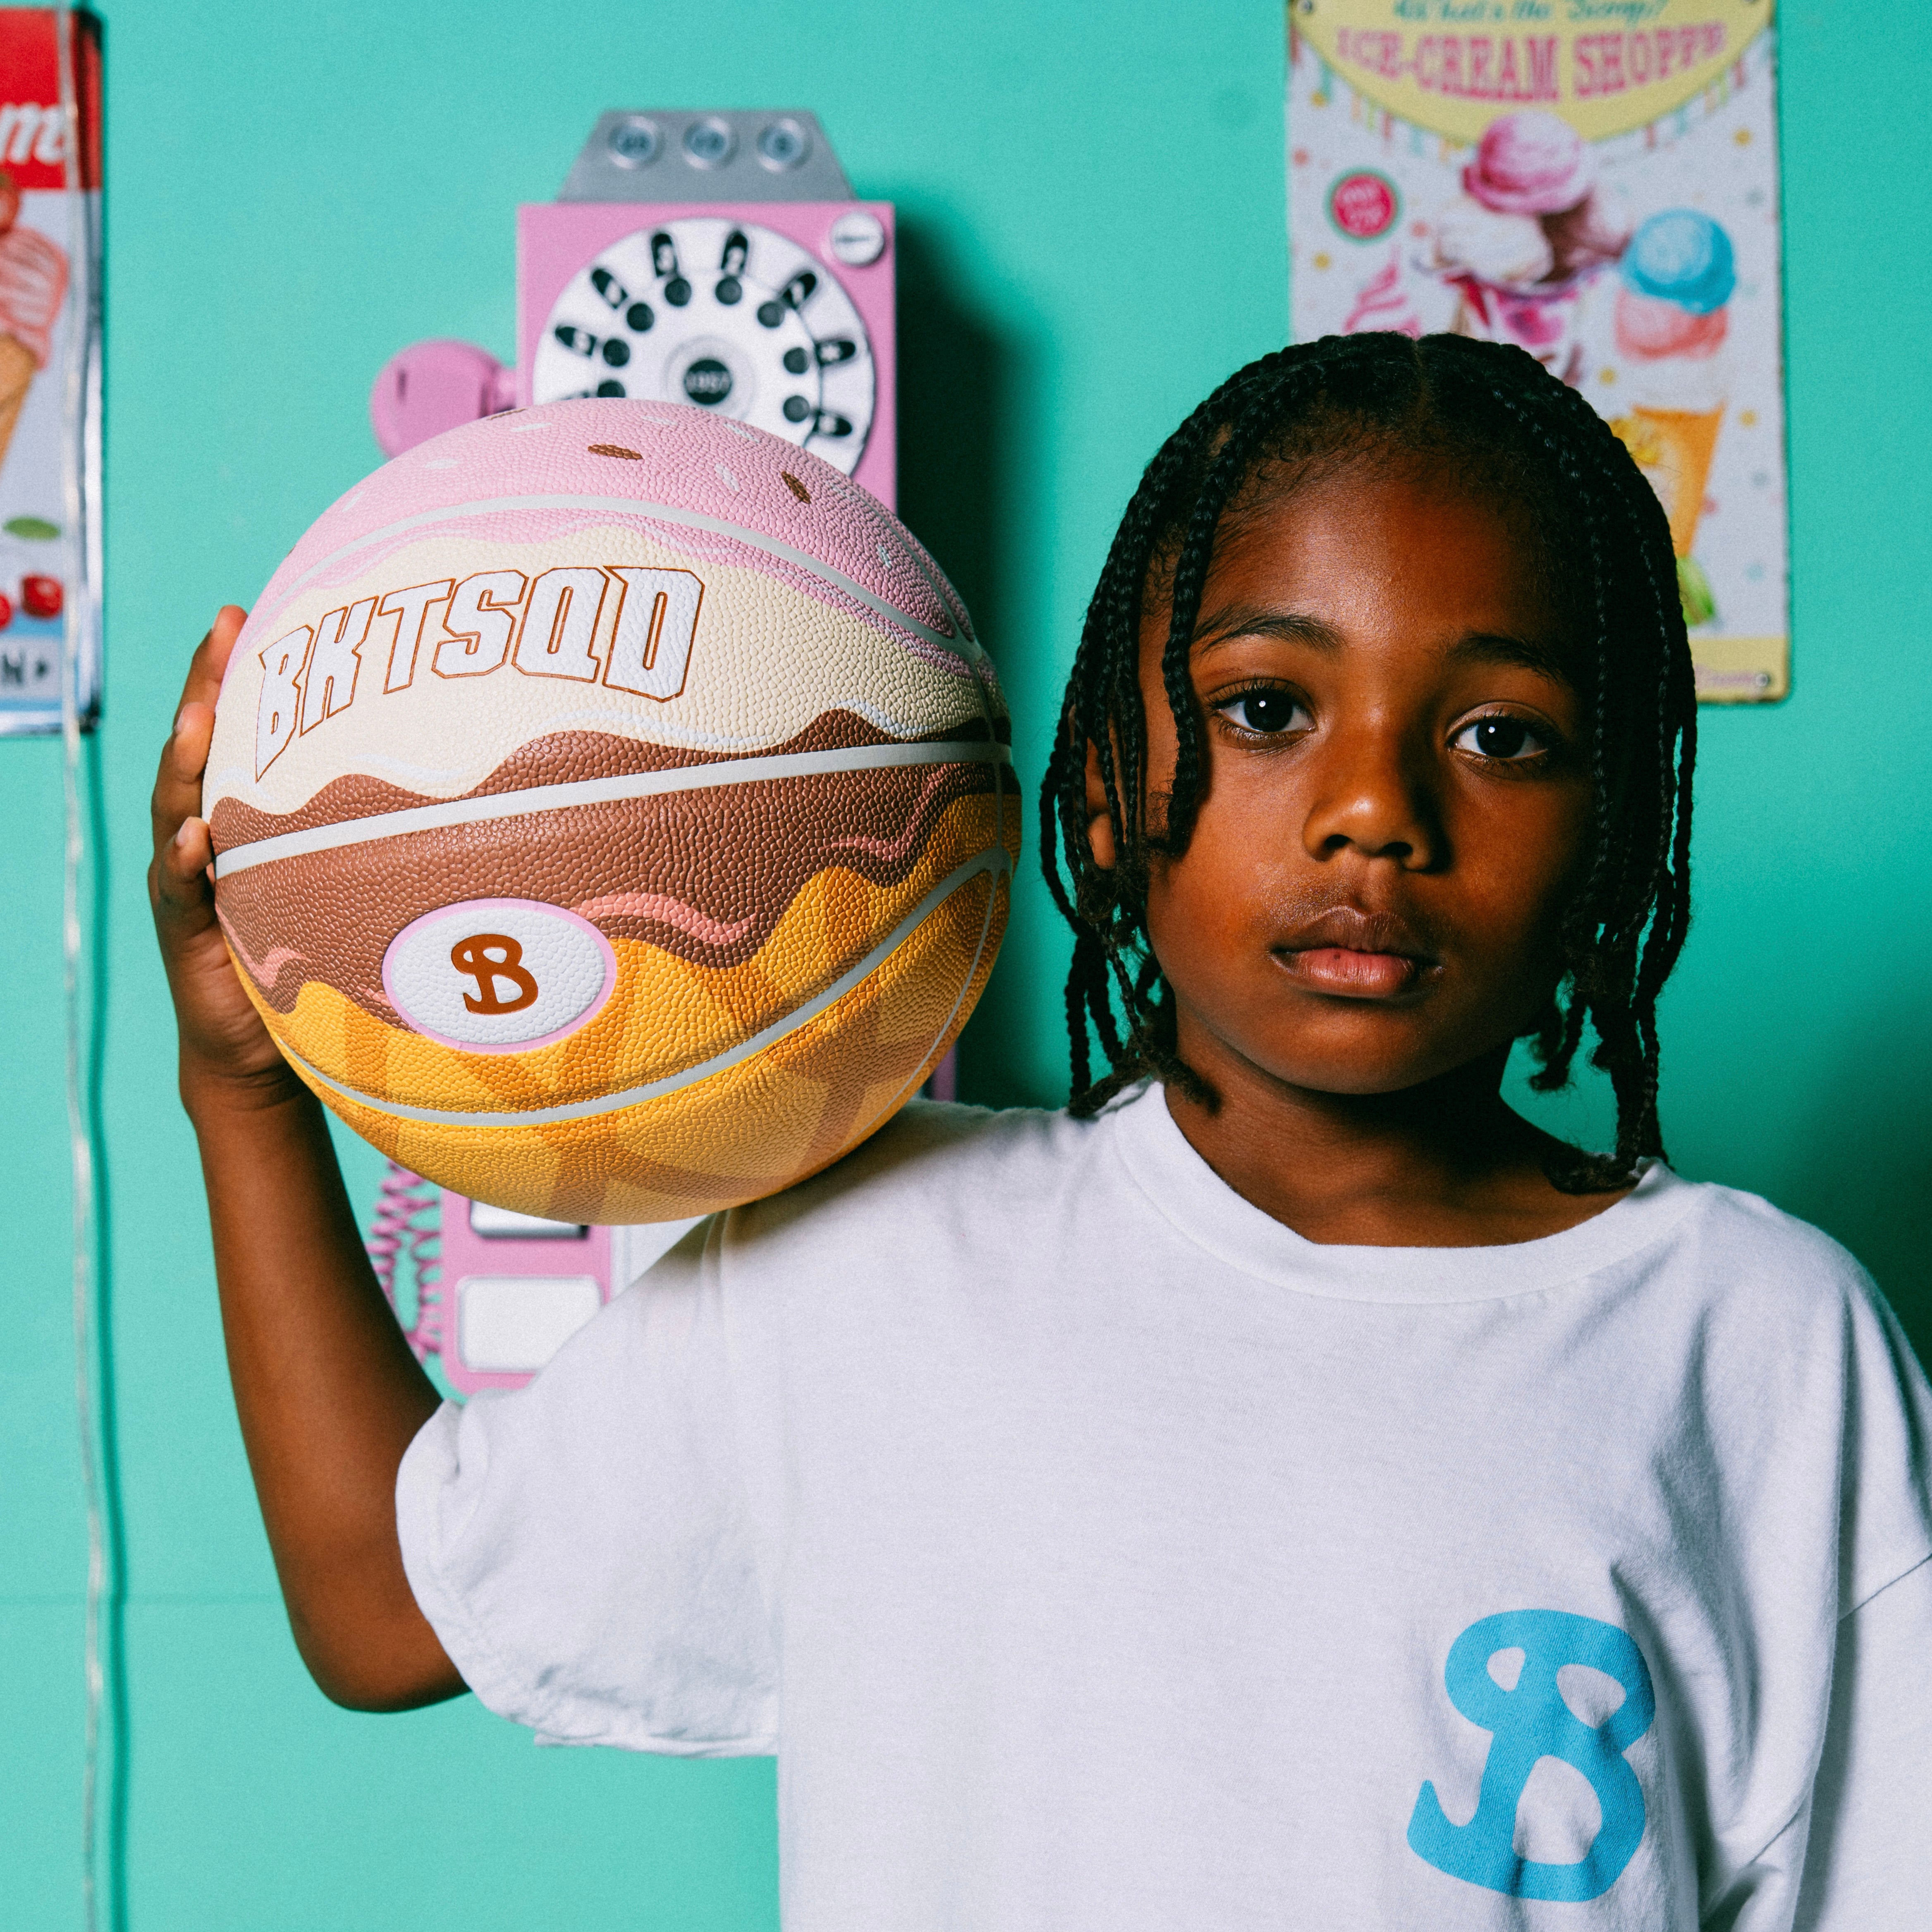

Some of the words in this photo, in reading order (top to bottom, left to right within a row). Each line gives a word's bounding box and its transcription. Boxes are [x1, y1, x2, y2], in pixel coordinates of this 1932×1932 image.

[1335, 26, 1559, 103] ICE-CREAM
[1572, 22, 1727, 100] SHOPPE
[255, 565, 705, 784] BKTSQD
[450, 933, 539, 1016] B
[1406, 1609, 1655, 1903] B
